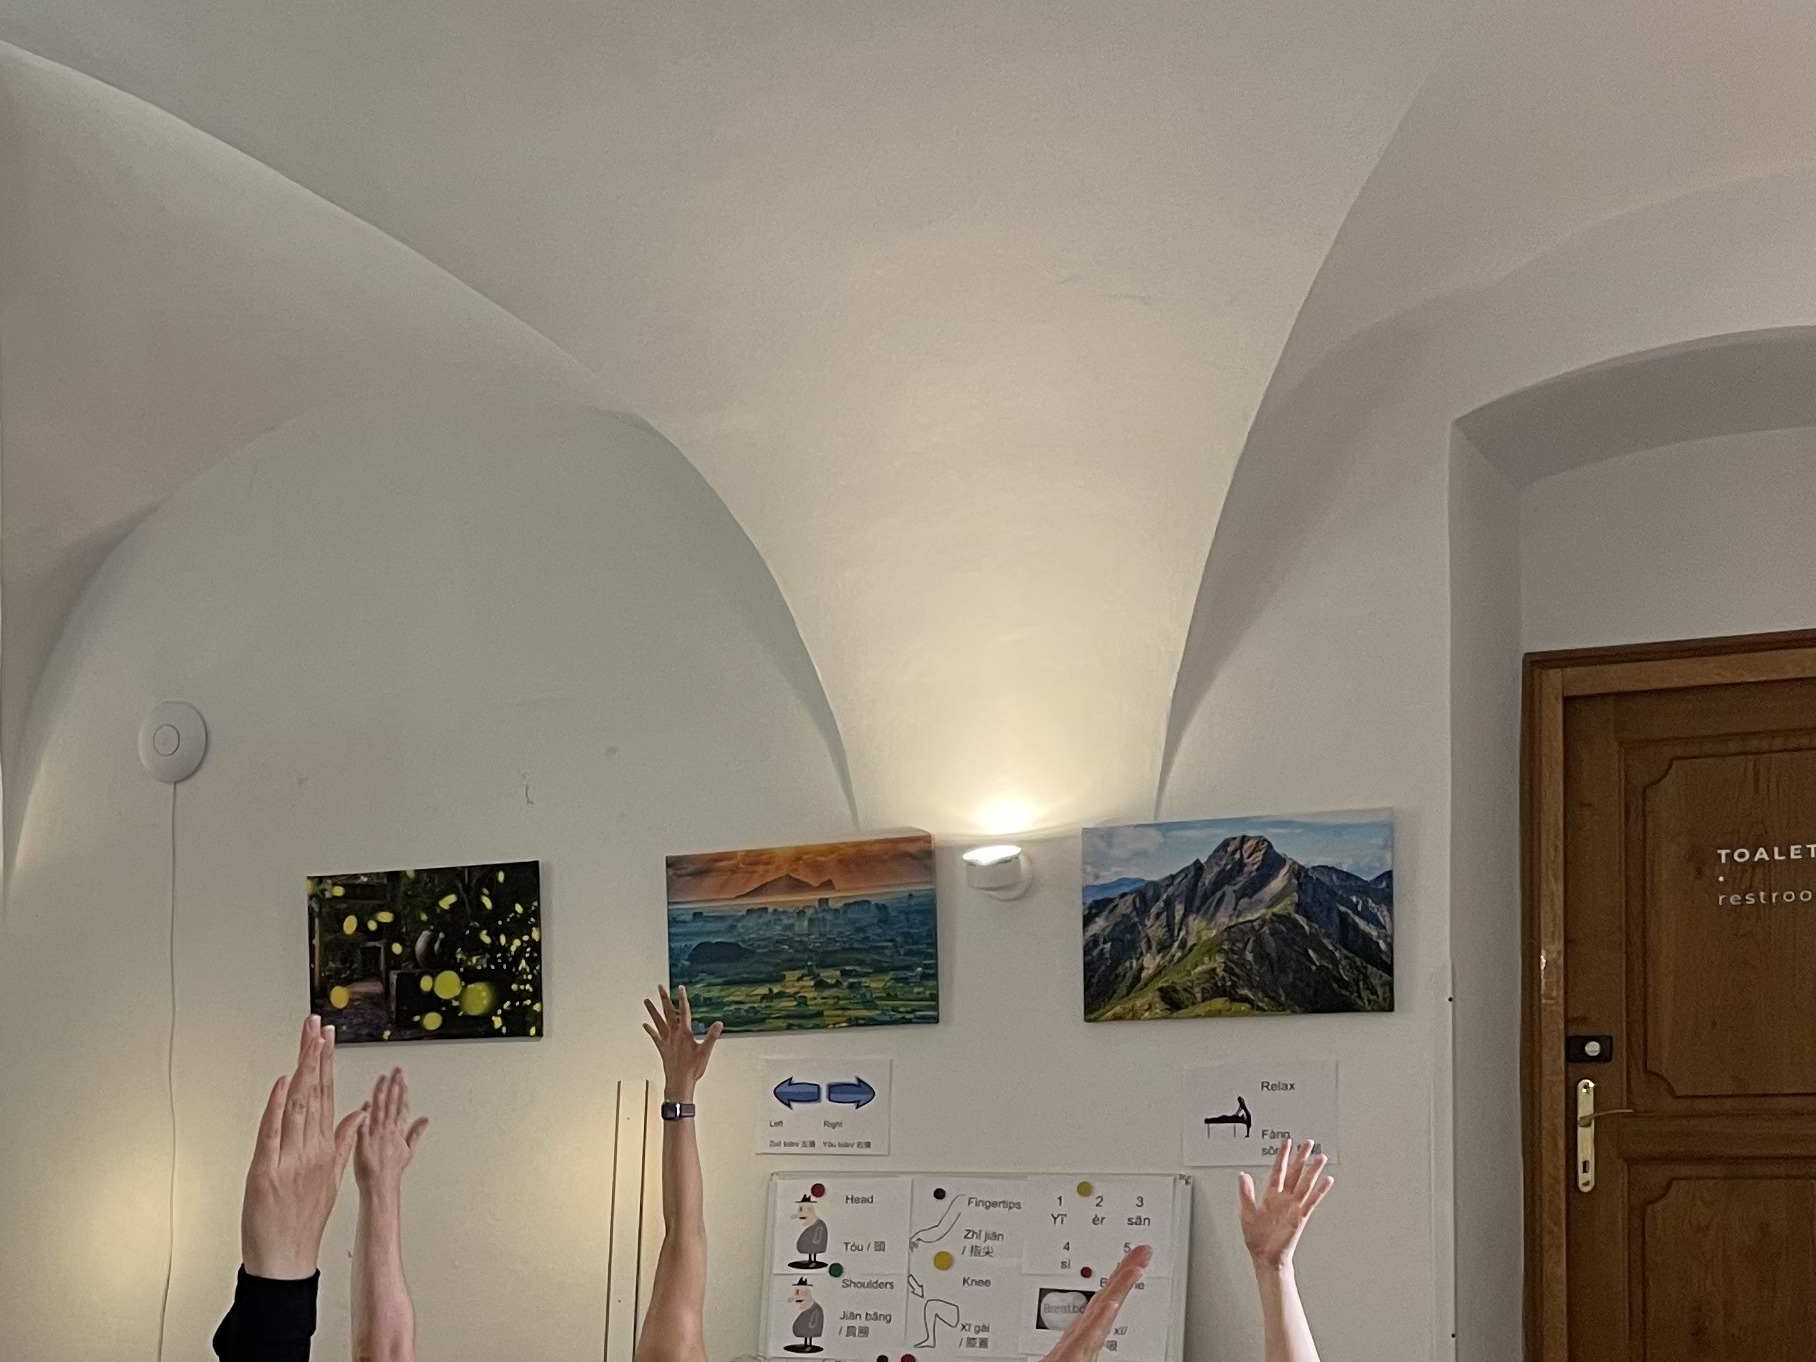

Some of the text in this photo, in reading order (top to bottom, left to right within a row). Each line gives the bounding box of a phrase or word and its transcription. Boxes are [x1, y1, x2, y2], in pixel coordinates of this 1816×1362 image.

[1261, 1081, 1295, 1092] Relax
[845, 1194, 874, 1205] Head
[967, 1196, 1022, 1211] Fingertips
[1057, 1195, 1144, 1208] 1 2 3
[1062, 1241, 1132, 1253] 4 5
[841, 1278, 894, 1290] Shoulders
[962, 1276, 991, 1287] Knee
